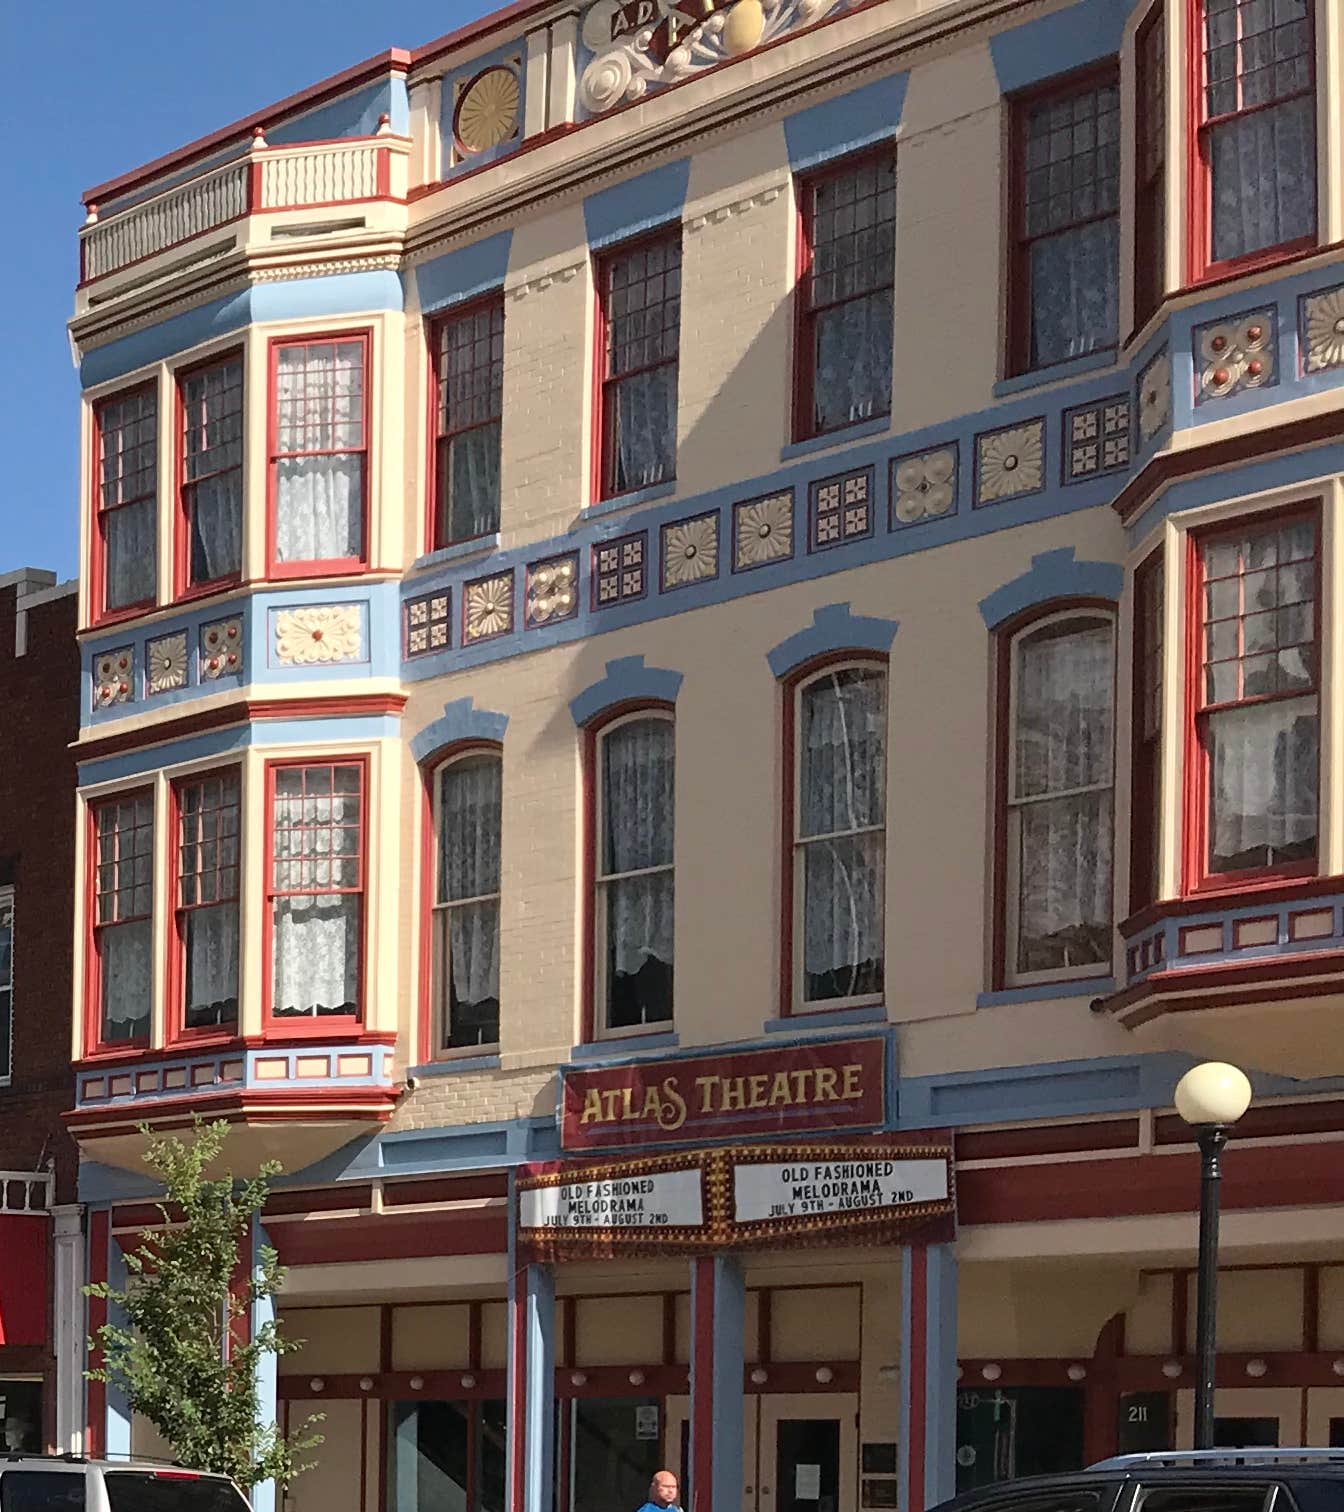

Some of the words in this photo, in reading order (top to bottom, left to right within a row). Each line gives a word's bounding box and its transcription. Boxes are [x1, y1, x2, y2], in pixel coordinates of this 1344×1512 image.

[580, 1077, 687, 1131] ATLAS
[695, 1064, 863, 1113] THEATRE
[781, 1167, 809, 1183] OLD
[815, 1162, 894, 1181] FASHIONED
[561, 1187, 582, 1200] OLD
[586, 1180, 654, 1198] FASHIONED
[792, 1179, 881, 1200] MELODRAMA
[568, 1199, 644, 1213] MELODRAMA
[768, 1203, 795, 1217] JULY
[801, 1200, 824, 1212] 9TH
[838, 1192, 884, 1209] AUGUST
[891, 1190, 914, 1203] 2ND
[543, 1215, 568, 1226] JULY
[573, 1214, 591, 1225] 9TH
[603, 1213, 644, 1225] AUGUST
[649, 1213, 669, 1224] 2ND
[1129, 1406, 1147, 1422] 211
